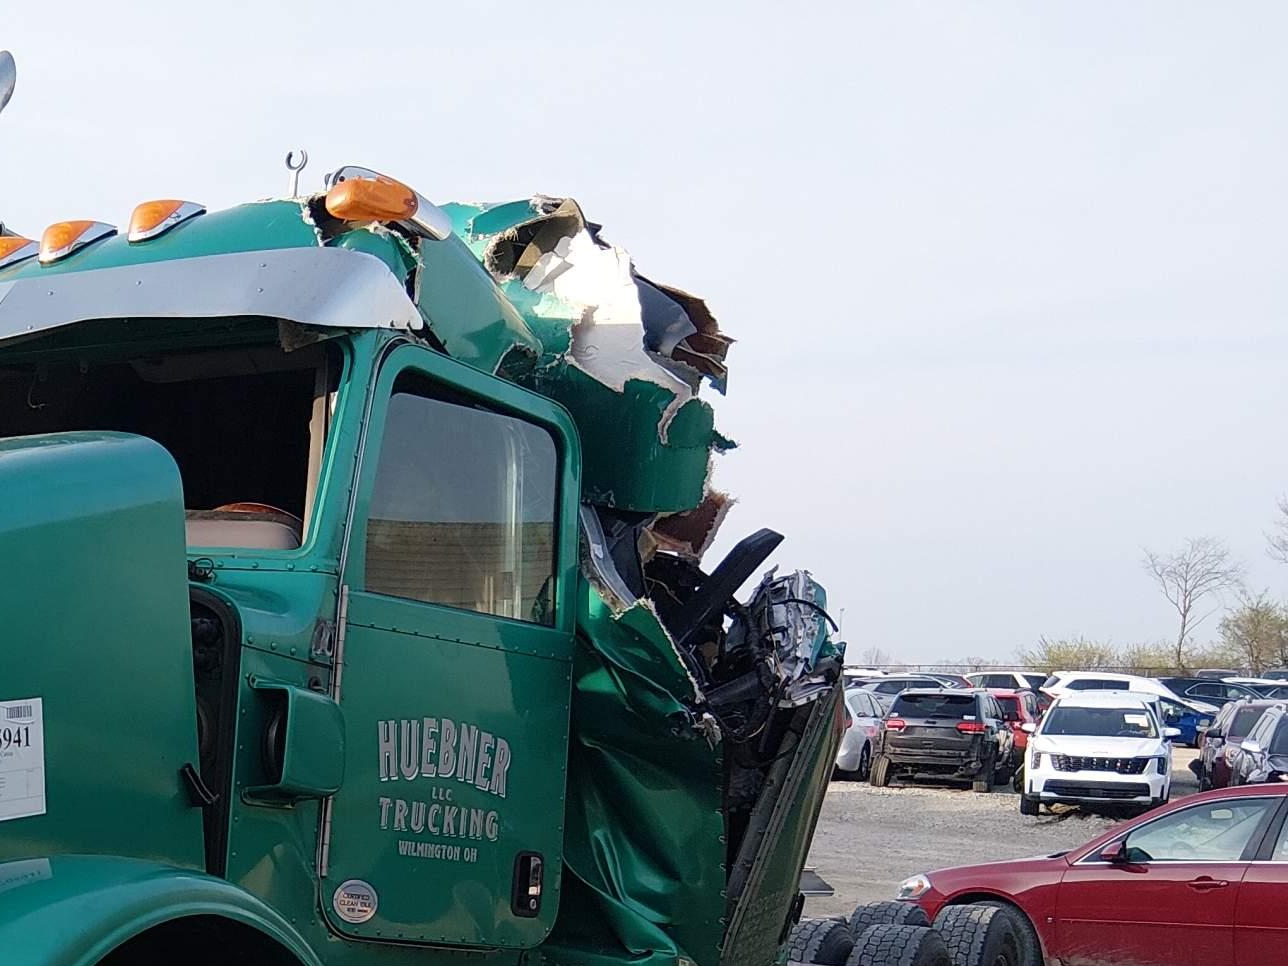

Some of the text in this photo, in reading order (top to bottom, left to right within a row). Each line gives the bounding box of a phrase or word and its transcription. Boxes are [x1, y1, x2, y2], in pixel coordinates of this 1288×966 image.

[378, 717, 511, 798] HUEBNER
[431, 786, 453, 801] LLC
[379, 797, 499, 842] TRUCKING
[398, 840, 478, 863] WILMINGTON OH
